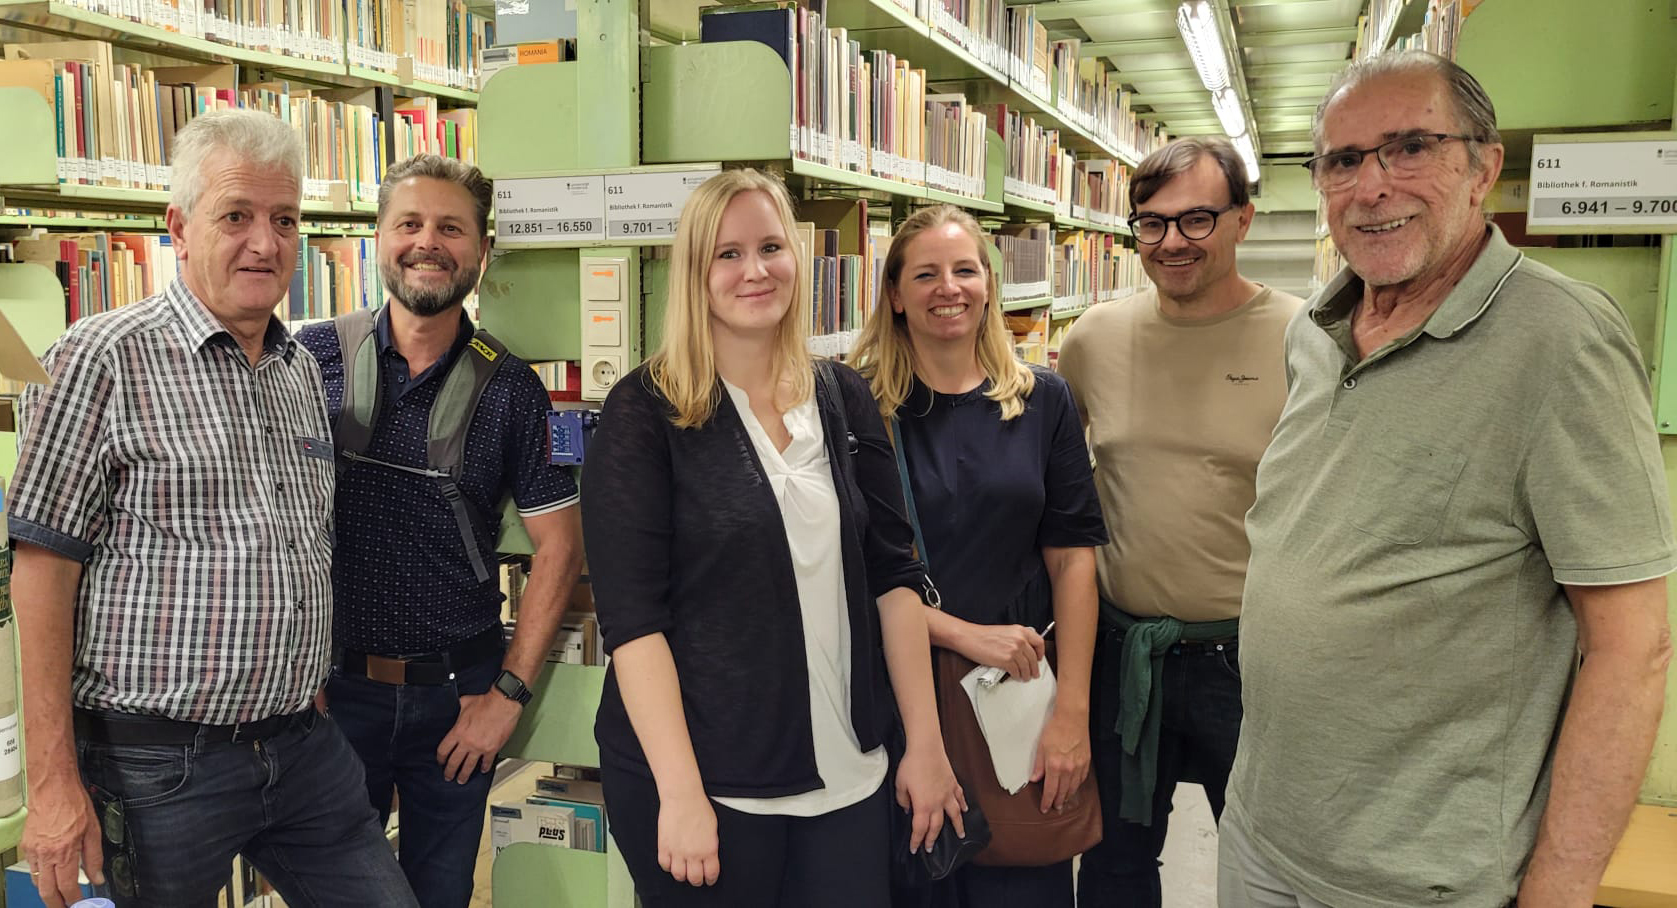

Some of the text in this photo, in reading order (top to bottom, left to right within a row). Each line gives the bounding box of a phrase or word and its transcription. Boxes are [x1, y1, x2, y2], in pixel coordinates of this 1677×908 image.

[1537, 158, 1561, 169] 611
[607, 185, 623, 195] 611
[1537, 181, 1579, 189] Bibliothek
[1590, 180, 1638, 188] Romanistik
[497, 190, 512, 199] 611
[1561, 201, 1608, 214] 6.941
[508, 223, 543, 234] 12.851
[557, 221, 592, 232] 16.550
[622, 222, 652, 233] 9.701
